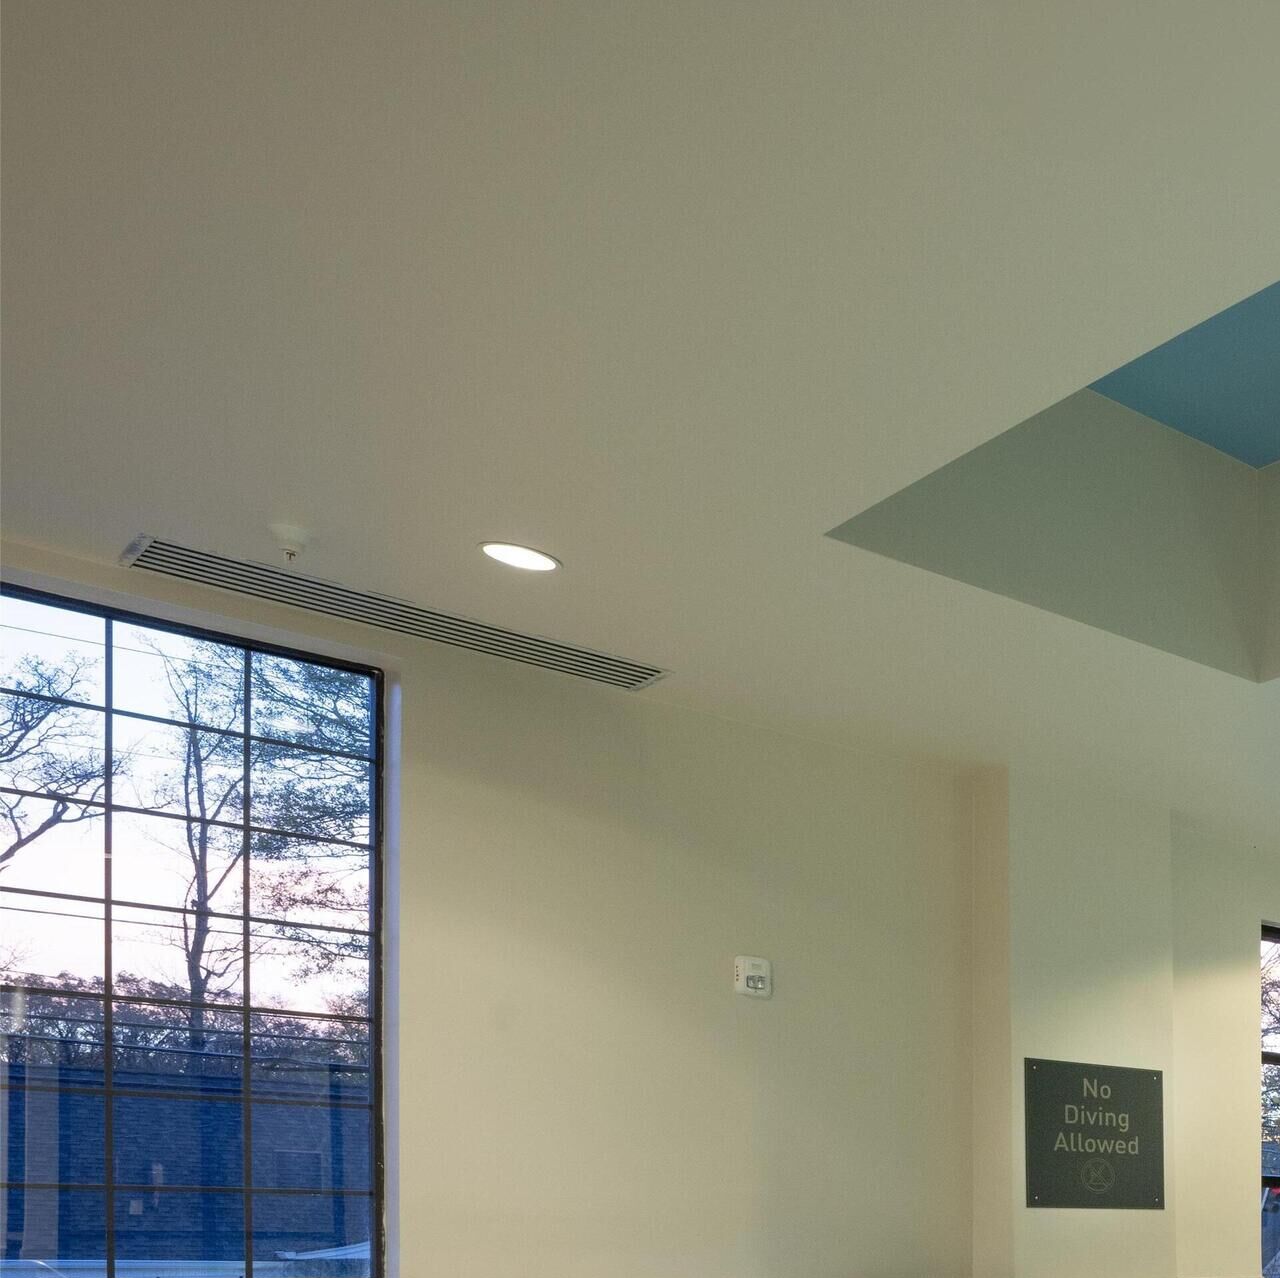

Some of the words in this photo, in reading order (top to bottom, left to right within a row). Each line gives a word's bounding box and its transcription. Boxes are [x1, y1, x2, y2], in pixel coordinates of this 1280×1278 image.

[1083, 1078, 1112, 1099] No
[1064, 1104, 1129, 1133] Diving
[1053, 1132, 1139, 1155] Allowed
